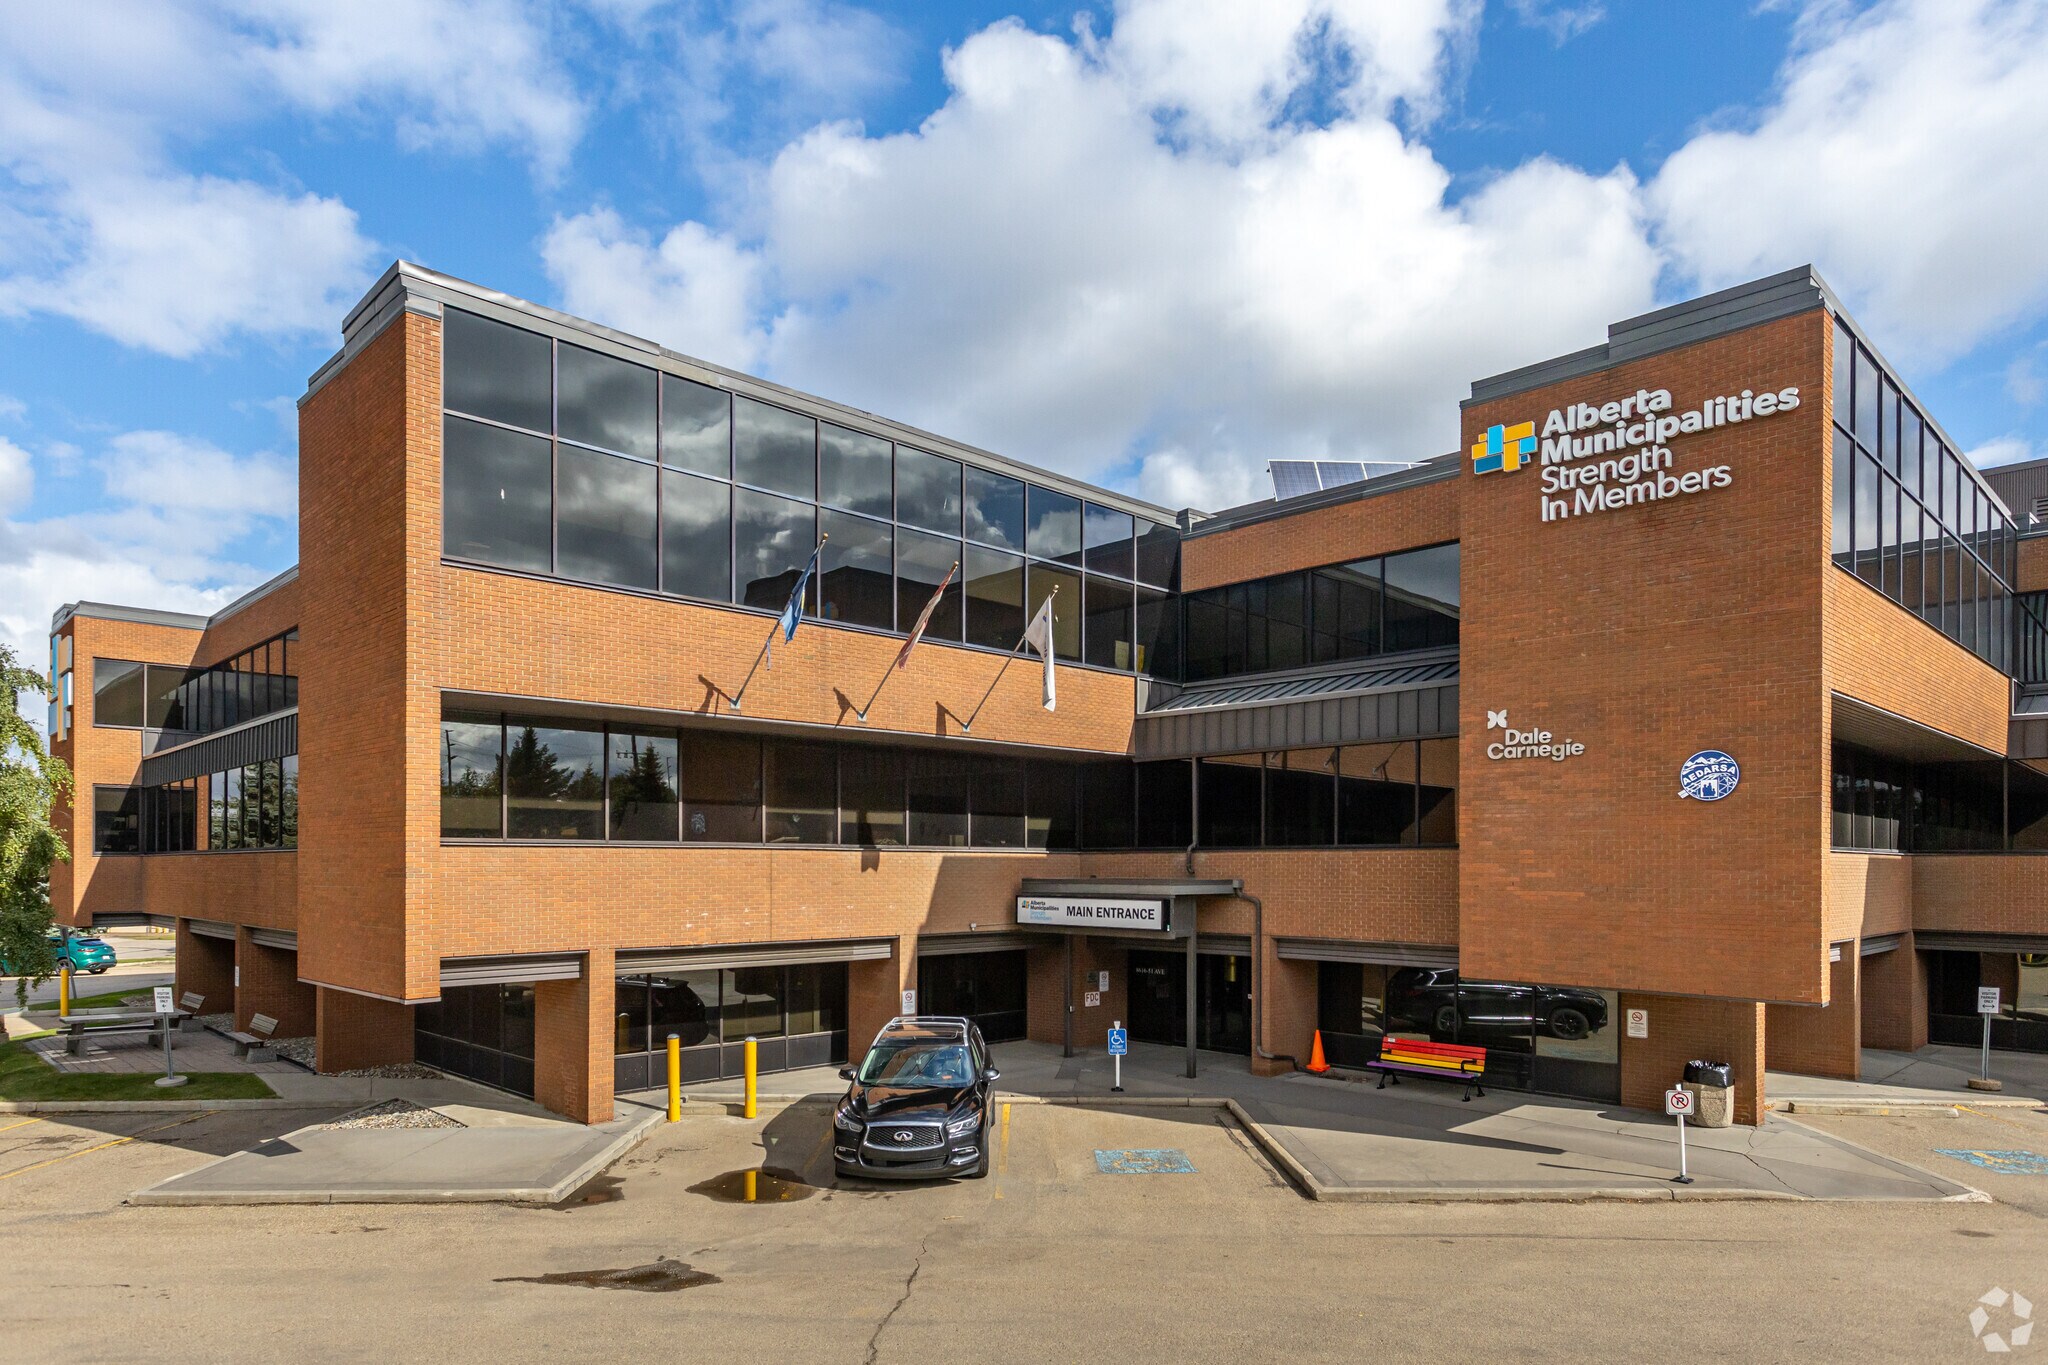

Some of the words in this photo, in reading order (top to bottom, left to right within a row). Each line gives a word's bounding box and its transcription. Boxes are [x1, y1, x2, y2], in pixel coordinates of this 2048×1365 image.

[1541, 388, 1672, 438] Alberta
[1541, 387, 1799, 466] Municipalities
[1541, 444, 1673, 494] Strength
[1541, 494, 1568, 522] In
[1574, 465, 1732, 516] Members
[1505, 728, 1552, 746] Dale
[1487, 738, 1585, 761] Carnegie
[1683, 764, 1735, 785] AEDARSA
[1066, 906, 1093, 917] MAIN
[1096, 907, 1155, 920] ENTRANCE
[1085, 992, 1099, 1002] FDC
